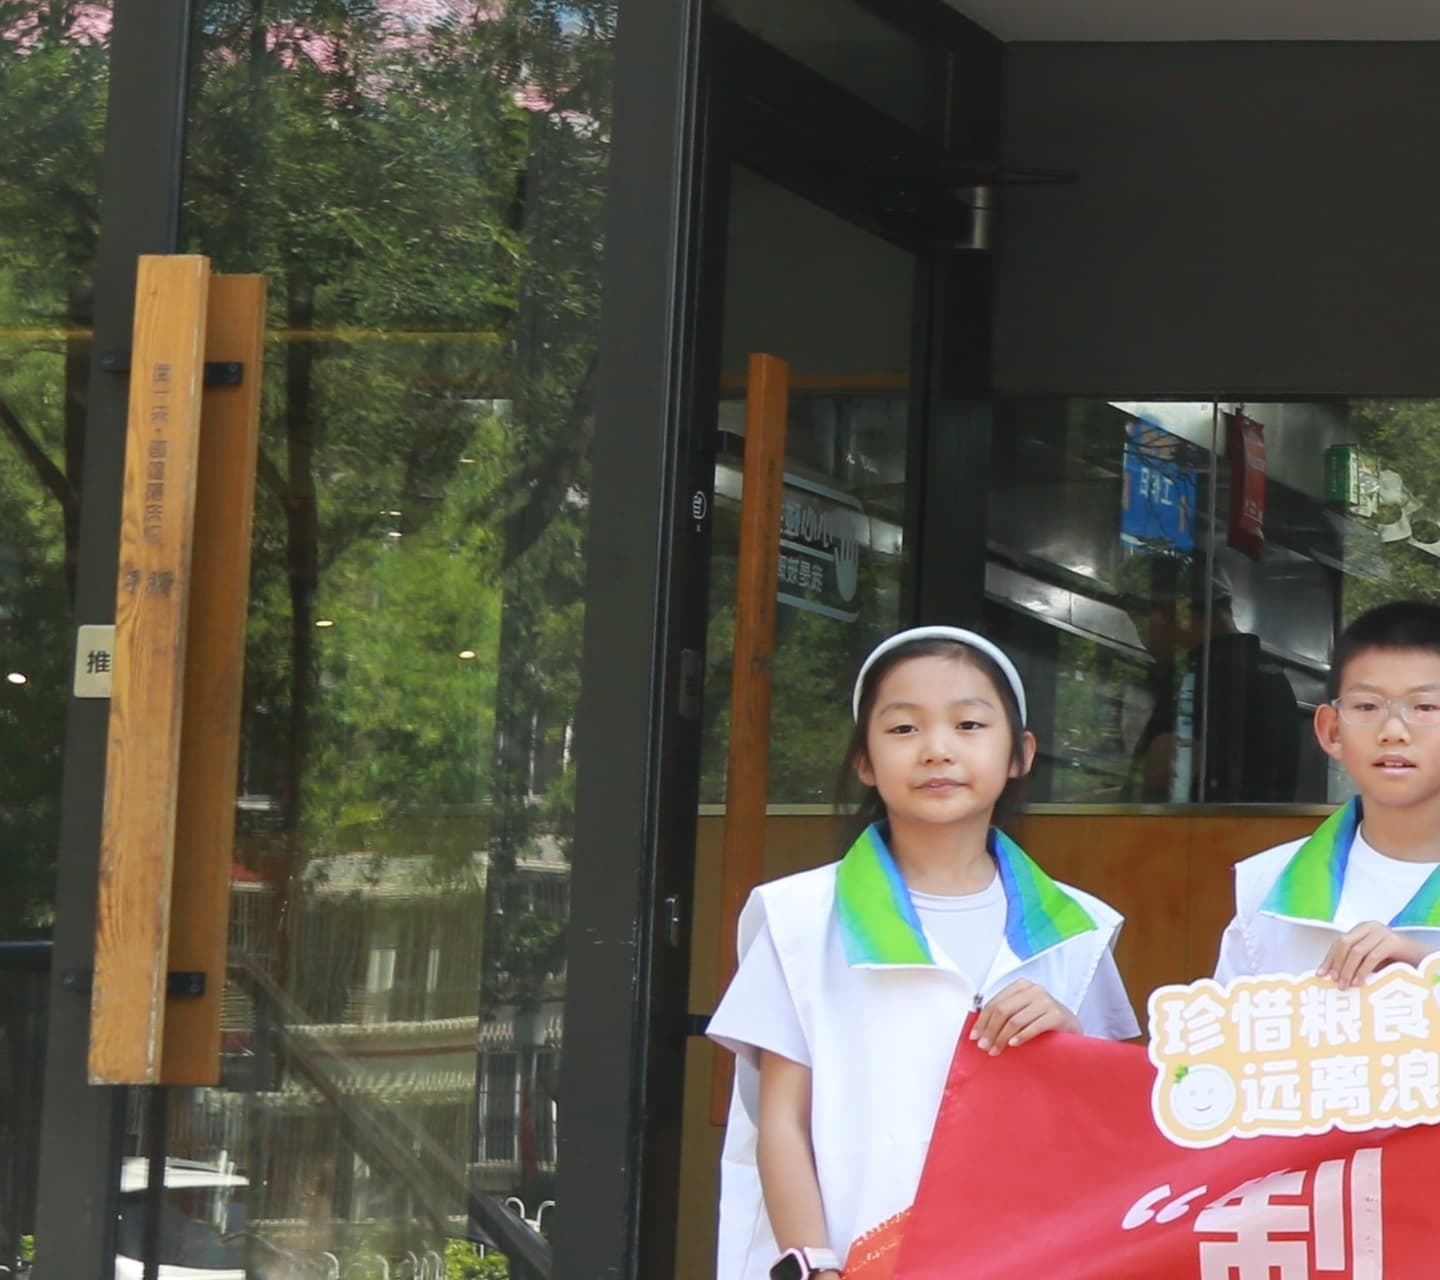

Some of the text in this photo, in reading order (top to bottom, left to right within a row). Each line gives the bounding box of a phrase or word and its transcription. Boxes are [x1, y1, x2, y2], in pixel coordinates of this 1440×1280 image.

[86, 649, 112, 674] 推
[1157, 981, 1432, 1058] 珍惜粮食
